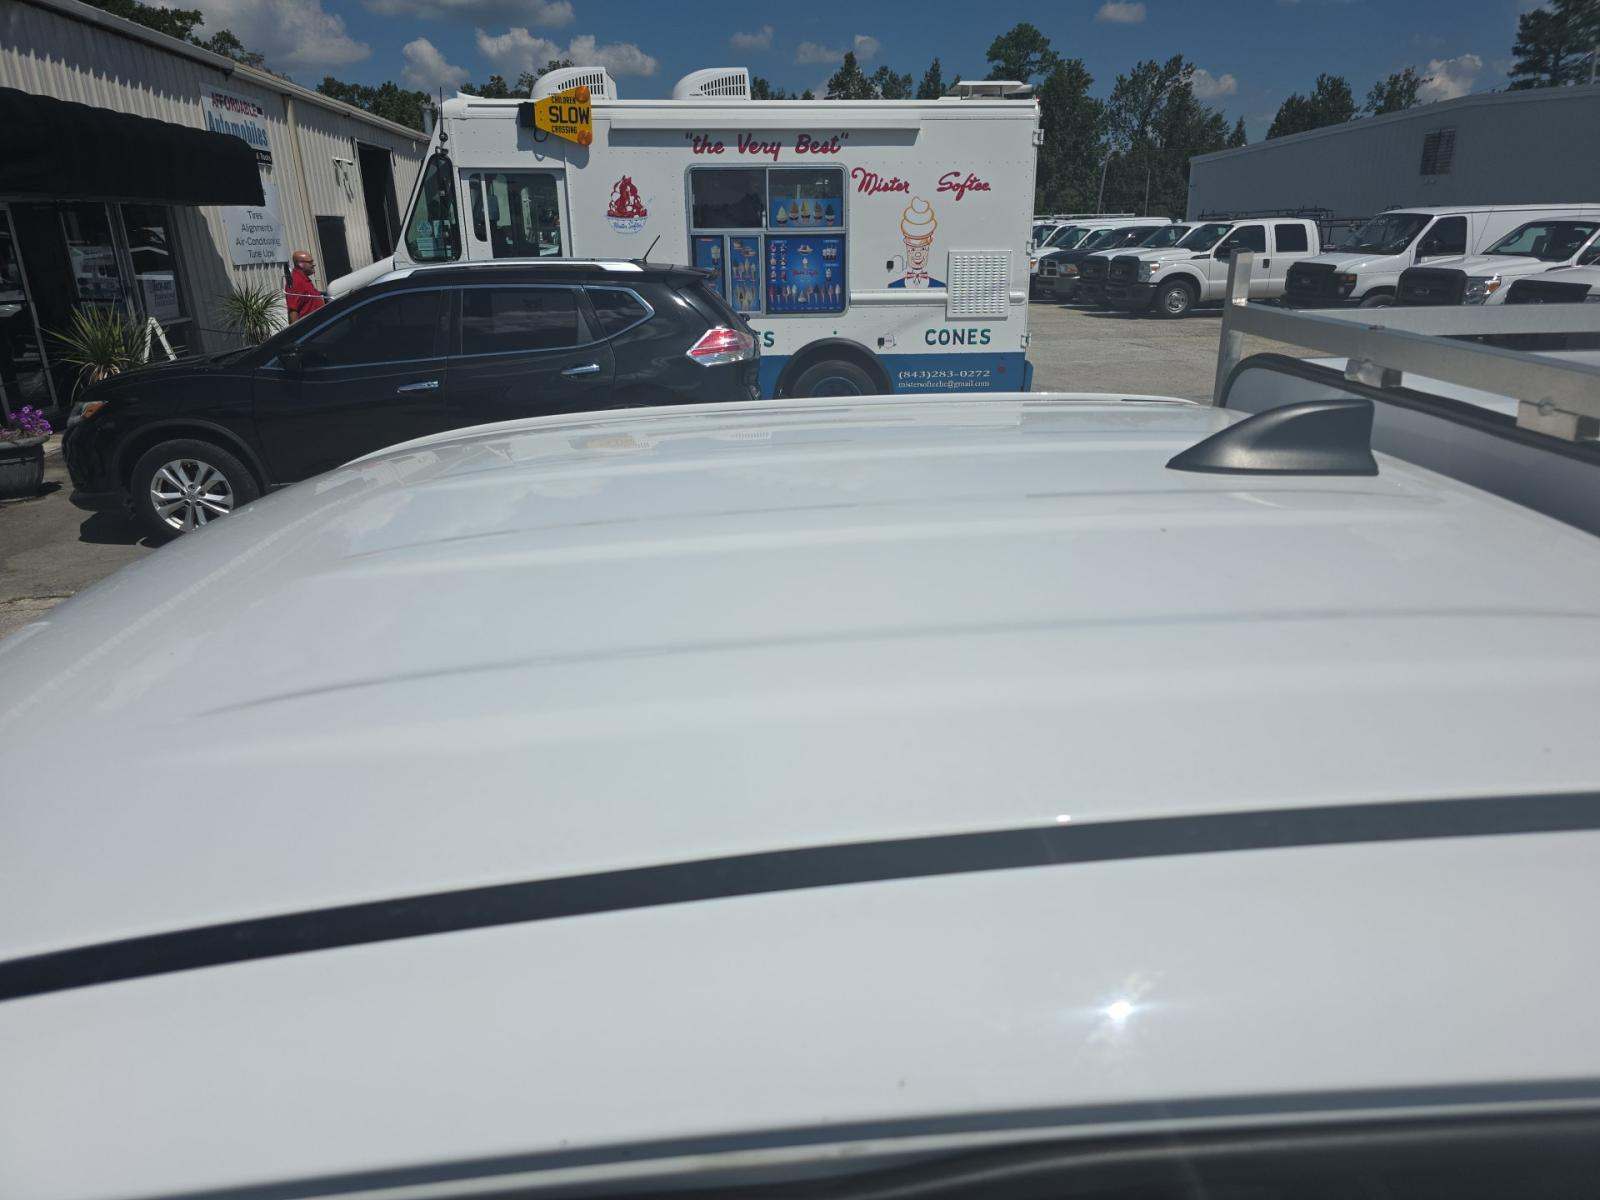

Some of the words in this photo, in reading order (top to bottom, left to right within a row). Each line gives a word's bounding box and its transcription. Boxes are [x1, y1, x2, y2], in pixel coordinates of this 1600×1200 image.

[551, 95, 576, 104] CHILDREN
[548, 105, 590, 125] SLOW
[551, 125, 578, 134] CROSSING
[737, 132, 782, 162] Very
[795, 131, 849, 154] Best"
[851, 167, 910, 196] Mister
[936, 171, 992, 201] Softee
[247, 210, 264, 220] Tires
[924, 328, 992, 346] CONES
[898, 370, 991, 379] (843)283-0272
